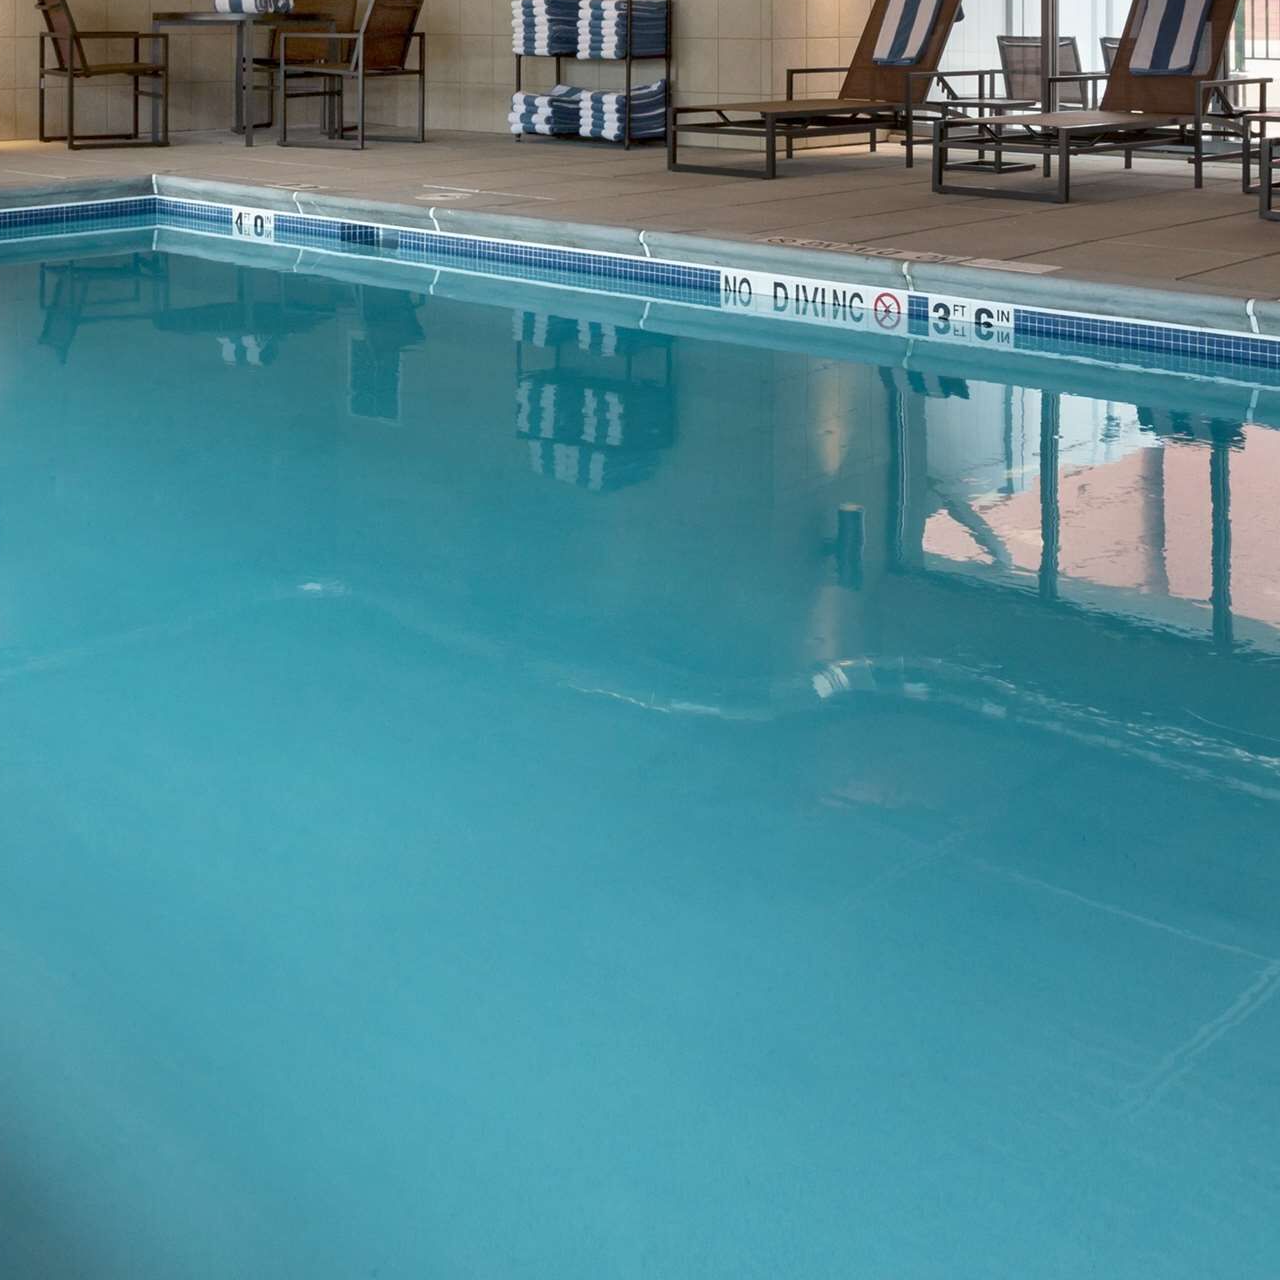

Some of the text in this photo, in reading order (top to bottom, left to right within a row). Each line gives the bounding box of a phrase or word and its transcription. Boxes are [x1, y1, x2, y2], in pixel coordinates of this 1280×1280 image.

[724, 274, 753, 304] NO
[932, 302, 951, 332] 3
[953, 303, 967, 317] FT
[996, 309, 1010, 323] IN
